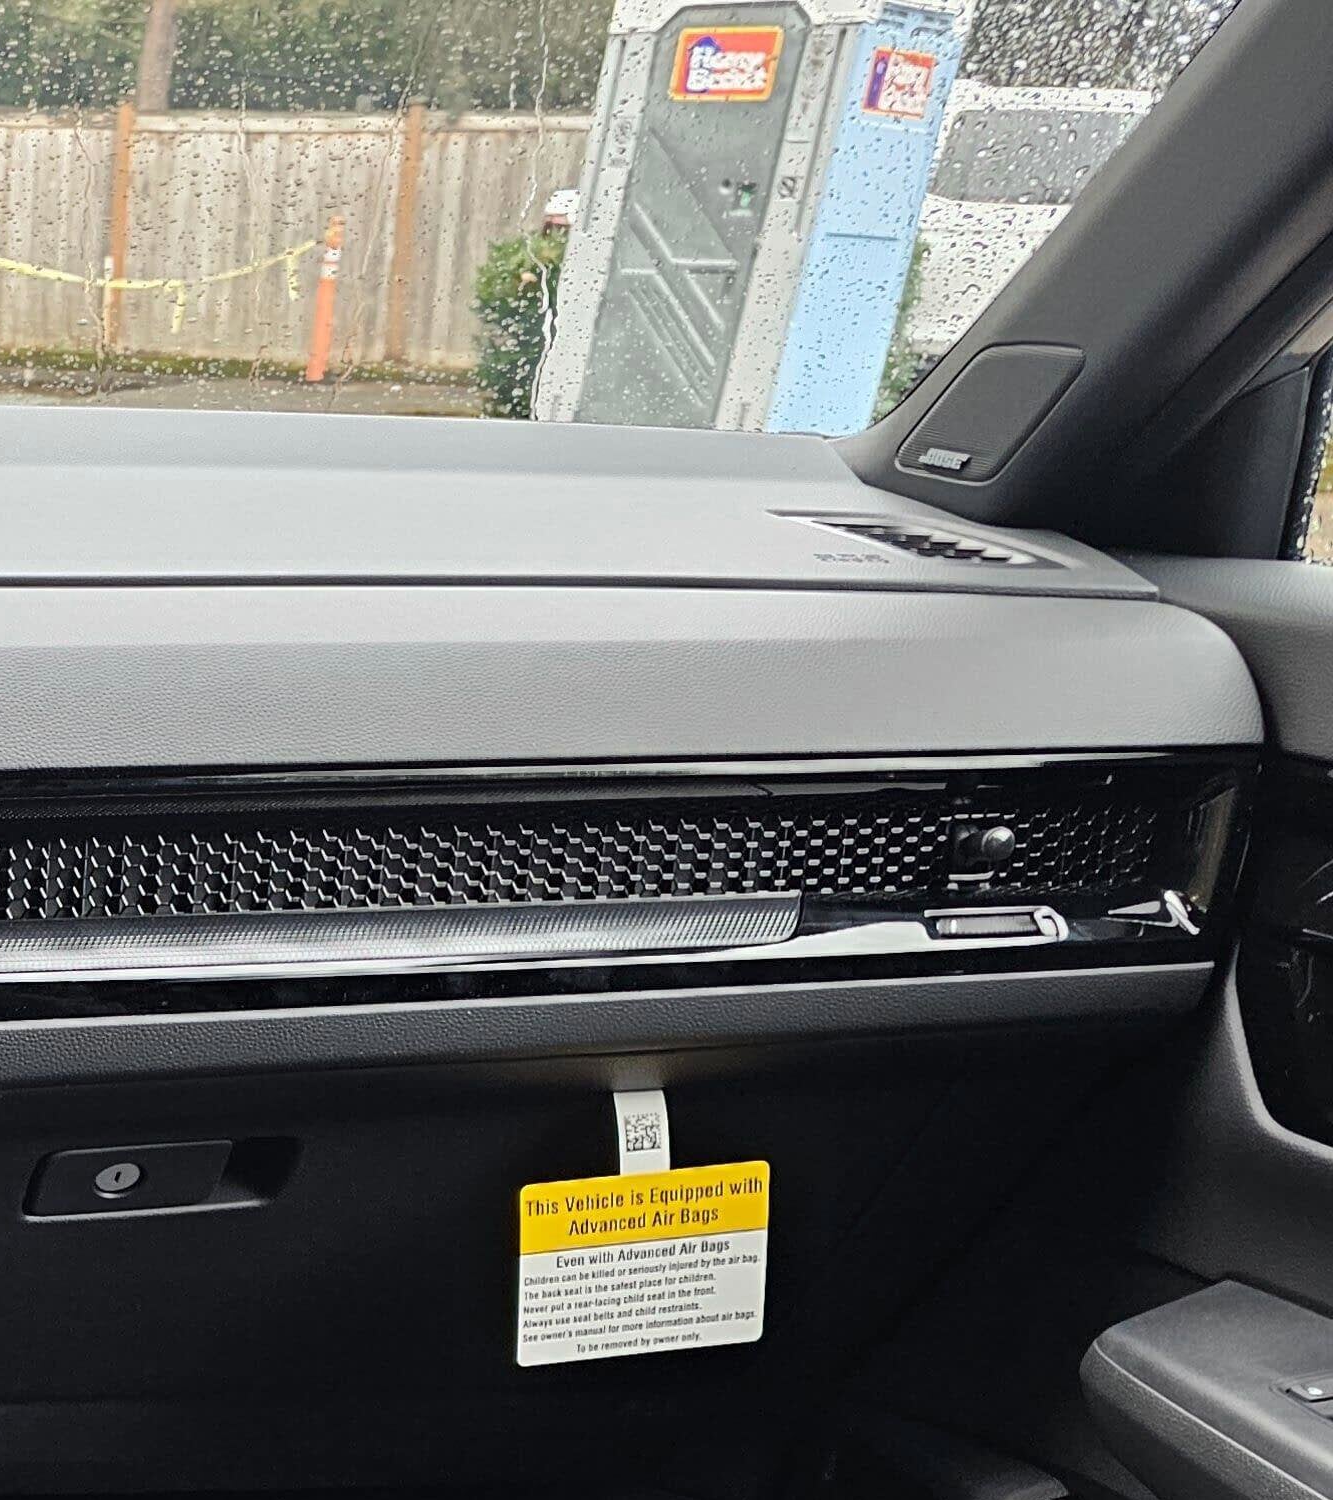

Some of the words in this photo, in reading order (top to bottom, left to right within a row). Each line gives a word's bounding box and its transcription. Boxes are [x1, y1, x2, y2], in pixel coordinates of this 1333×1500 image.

[526, 1200, 559, 1216] This
[566, 1193, 624, 1212] Vehicle
[631, 1190, 643, 1206] is
[651, 1181, 723, 1205] Equipped
[730, 1178, 762, 1195] with
[569, 1213, 646, 1235] Advanced
[652, 1211, 675, 1227] Air
[681, 1207, 719, 1223] Bags
[556, 1256, 585, 1268] Even
[589, 1251, 614, 1264] with
[618, 1244, 676, 1261] Advanced
[679, 1242, 698, 1255] Air
[701, 1240, 730, 1254] Bags
[524, 1276, 560, 1286] Children
[562, 1274, 577, 1282] can
[592, 1268, 615, 1278] killed
[628, 1262, 667, 1275] seriously
[669, 1260, 698, 1272] injured
[713, 1257, 726, 1266] the
[728, 1256, 740, 1265] air
[742, 1254, 760, 1264] bag.
[525, 1291, 539, 1300] The
[541, 1288, 561, 1298] back
[564, 1286, 583, 1296] seat
[595, 1284, 608, 1293] the
[611, 1281, 637, 1291] safest
[639, 1279, 662, 1289] place
[665, 1276, 677, 1285] for
[678, 1272, 717, 1284] children.
[523, 1305, 549, 1315] Never
[551, 1303, 564, 1313] put
[574, 1296, 621, 1309] rear-facing
[623, 1293, 644, 1304] child
[646, 1290, 666, 1301] seat
[678, 1289, 691, 1298] the
[693, 1286, 717, 1296] front.
[523, 1319, 553, 1329] Always
[555, 1317, 571, 1325] use
[573, 1313, 592, 1323] seat
[593, 1312, 614, 1322] belts
[617, 1309, 632, 1318] and
[635, 1307, 656, 1317] child
[658, 1302, 703, 1314] restraints.
[523, 1333, 538, 1343] See
[540, 1330, 572, 1341] owner's
[575, 1325, 606, 1337] manual
[608, 1324, 620, 1333] for
[621, 1321, 643, 1331] more
[645, 1316, 693, 1329] information
[695, 1314, 720, 1324] about
[721, 1312, 733, 1321] air
[734, 1310, 758, 1320] bags.
[601, 1339, 638, 1350] removed
[653, 1335, 679, 1345] owner
[681, 1332, 703, 1342] only.
